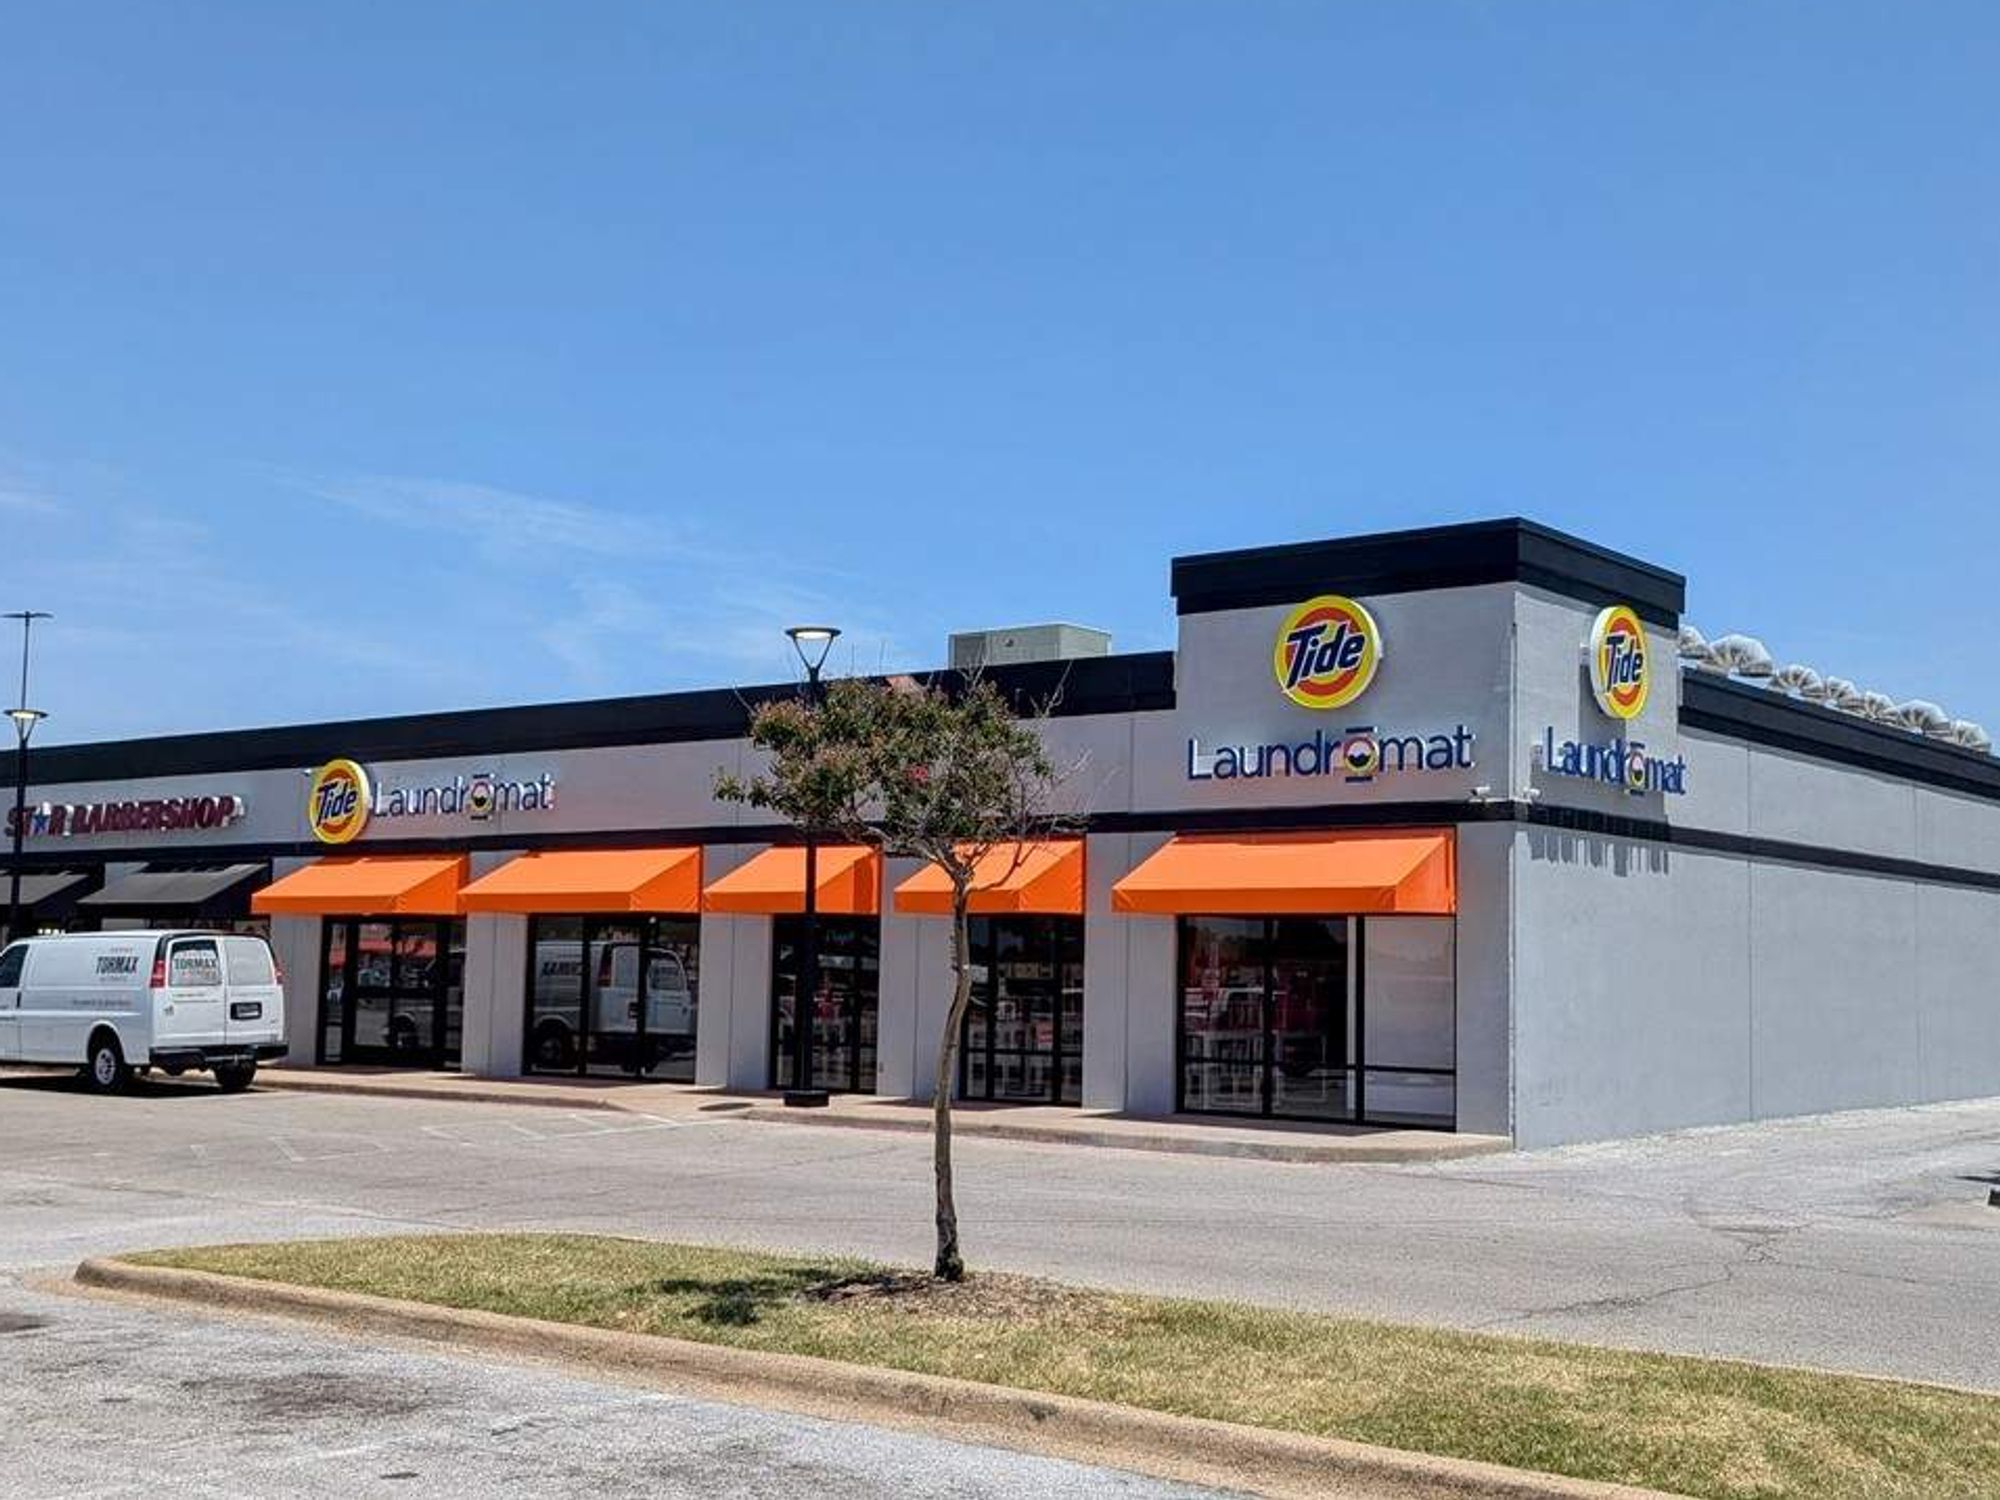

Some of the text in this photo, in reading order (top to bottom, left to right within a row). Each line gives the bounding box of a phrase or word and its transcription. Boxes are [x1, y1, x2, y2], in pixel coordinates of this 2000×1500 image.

[1286, 621, 1366, 692] Tide
[1604, 632, 1645, 695] Tide
[1187, 724, 1475, 783] Laundromat
[1546, 725, 1686, 797] Laundromat
[71, 795, 240, 834] BARBERSHOP
[316, 778, 358, 829] Tide
[372, 773, 555, 821] Laundromat
[96, 956, 140, 974] TORMAX
[174, 957, 217, 971] TORMAX
